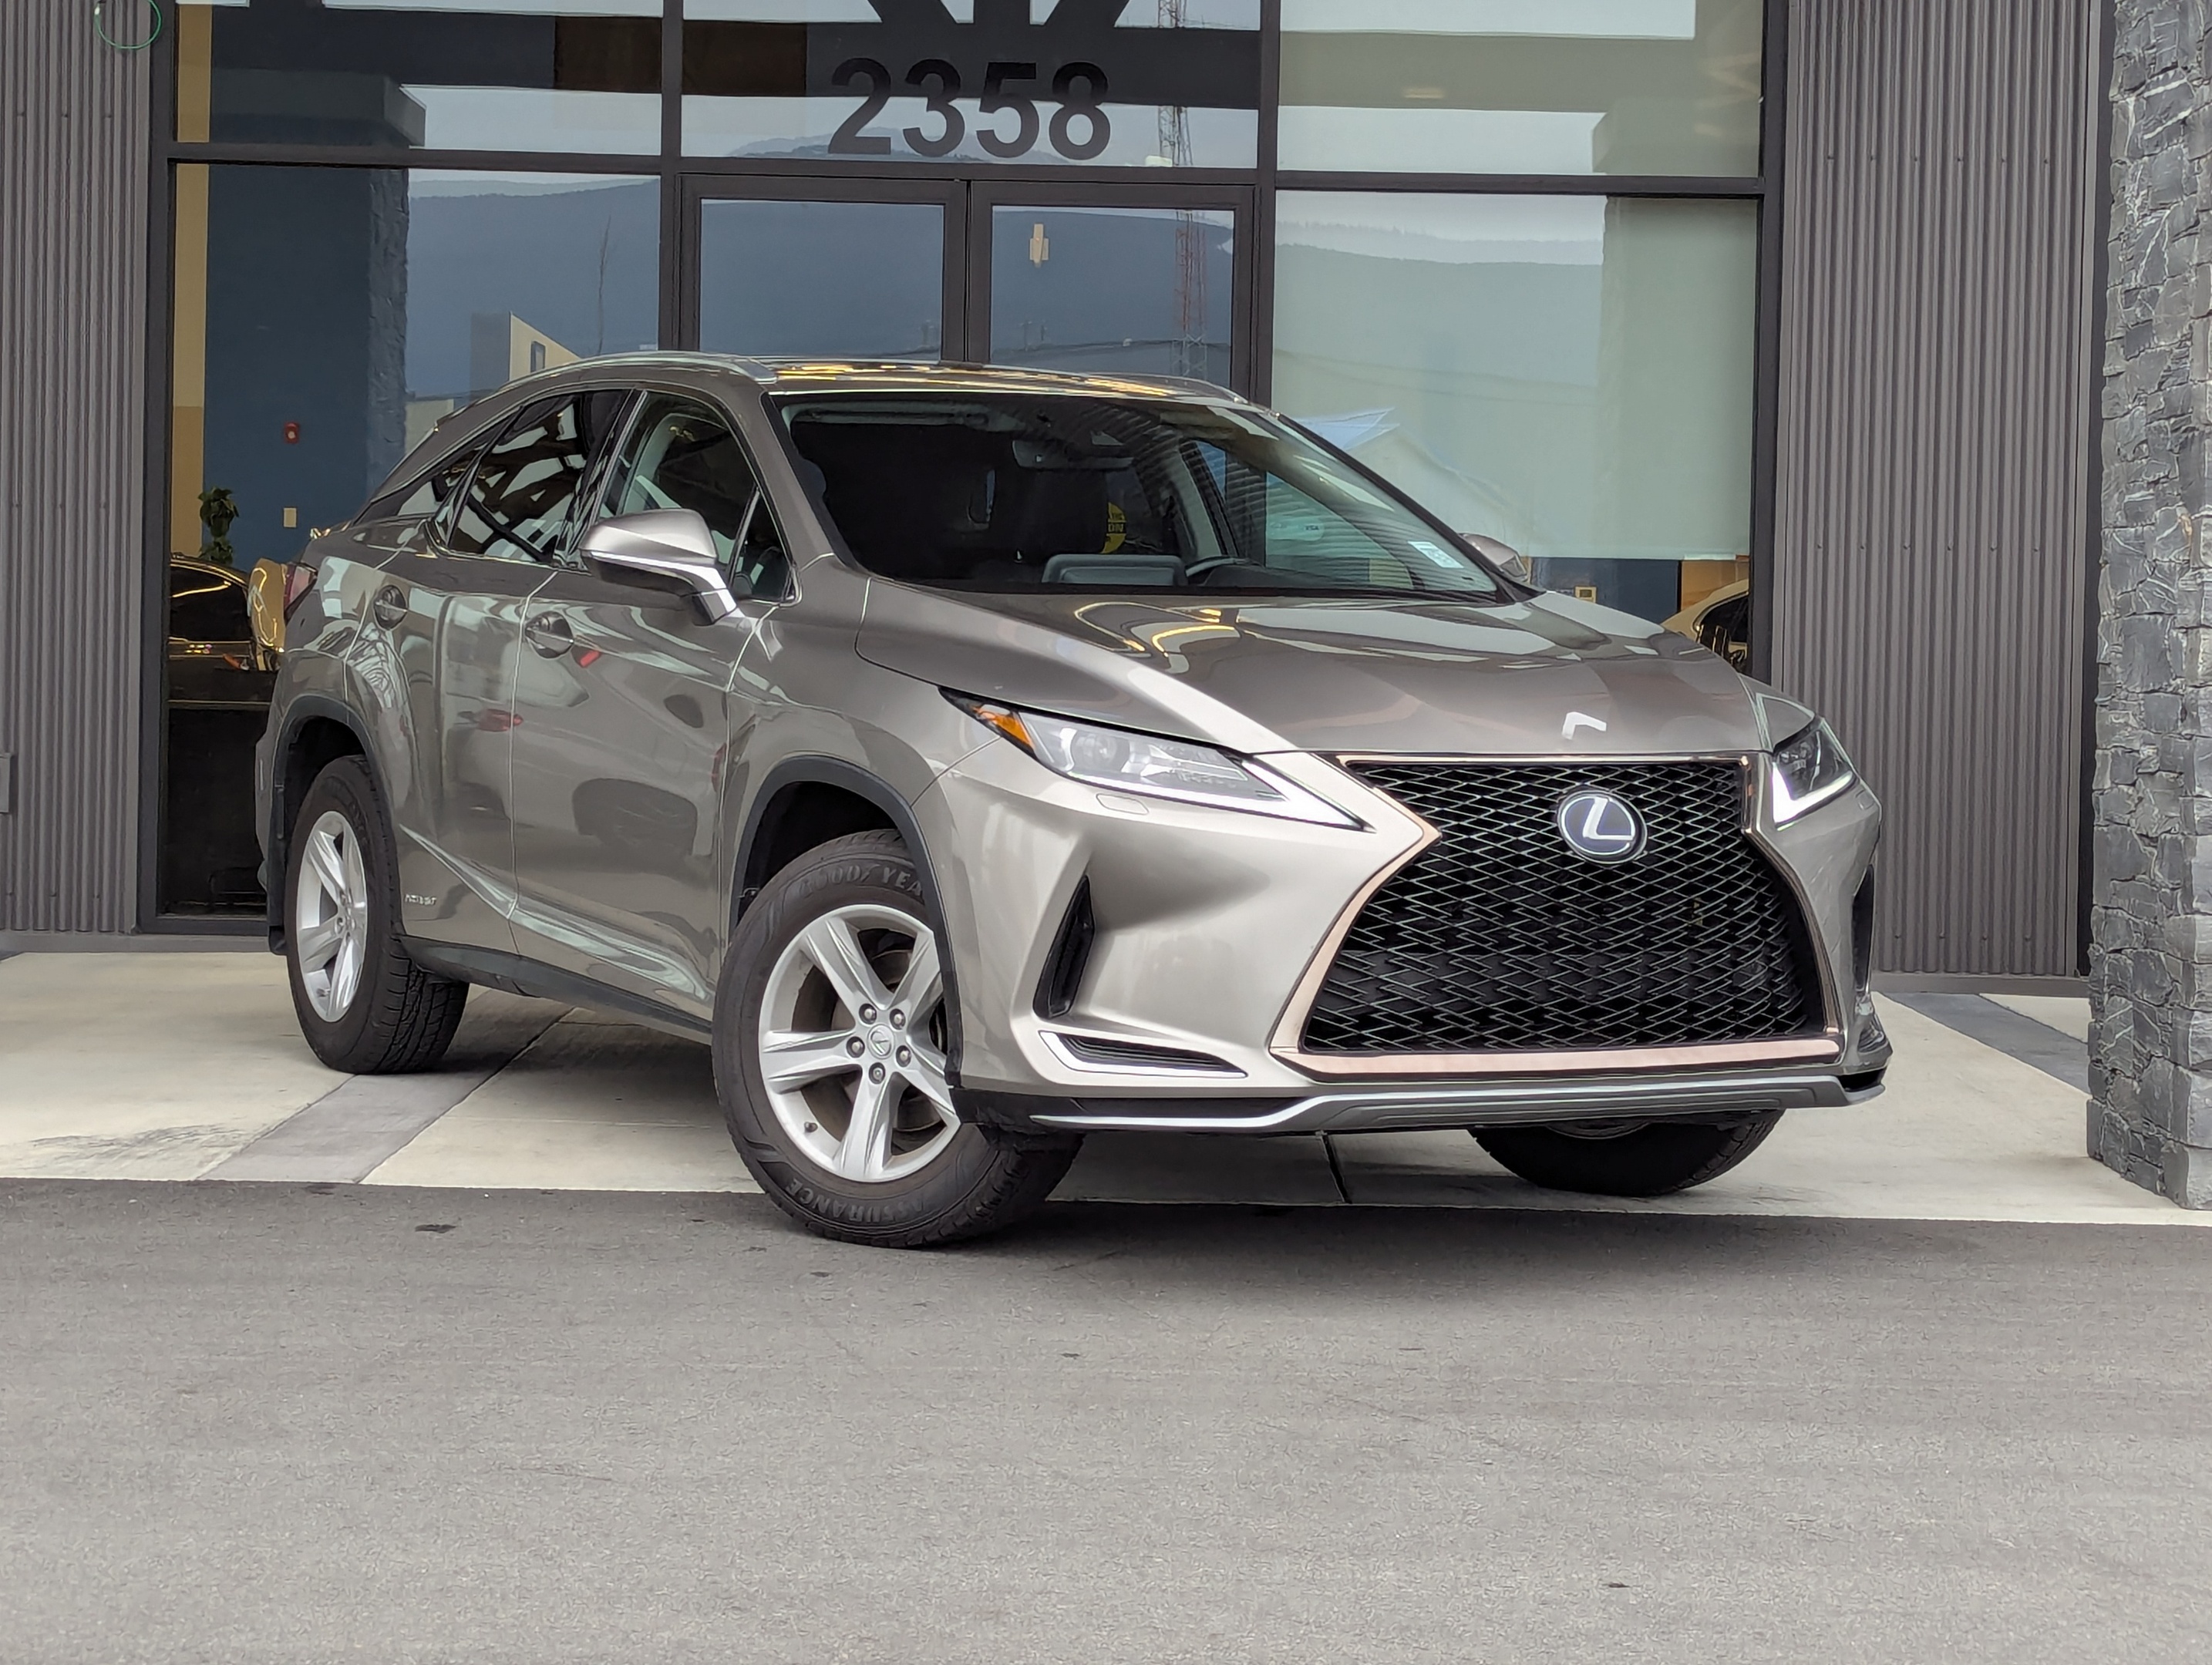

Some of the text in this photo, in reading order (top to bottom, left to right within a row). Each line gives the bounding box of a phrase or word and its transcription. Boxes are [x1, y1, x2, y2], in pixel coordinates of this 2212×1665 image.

[827, 57, 1111, 160] 2358
[799, 863, 924, 900] GOODYEA
[785, 1178, 924, 1224] ASSURANCE
